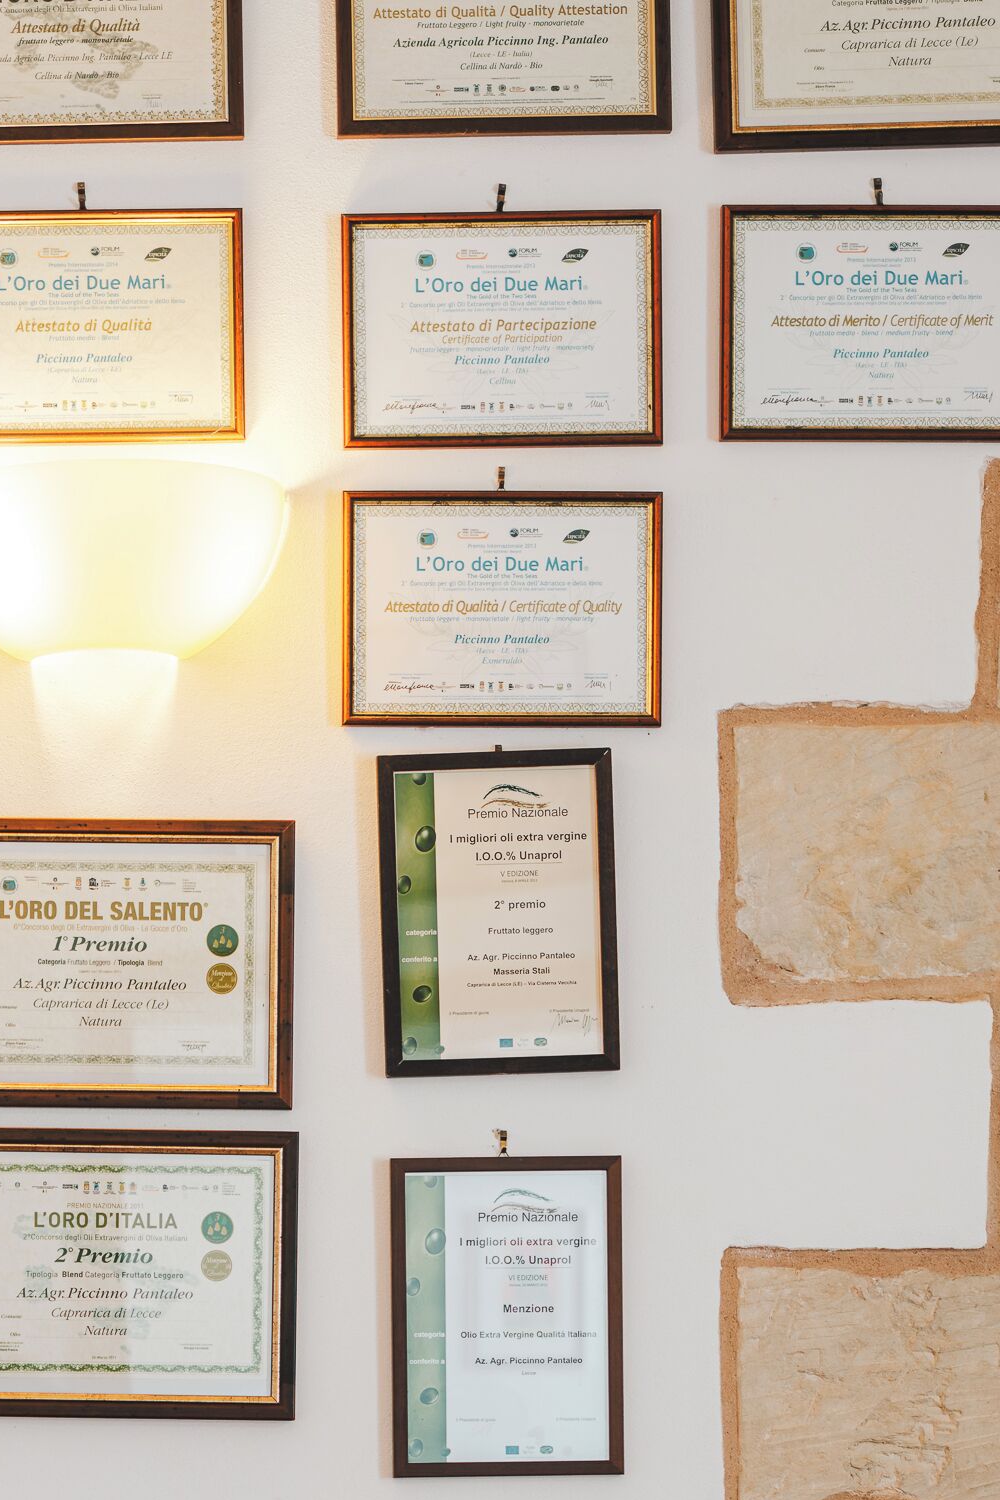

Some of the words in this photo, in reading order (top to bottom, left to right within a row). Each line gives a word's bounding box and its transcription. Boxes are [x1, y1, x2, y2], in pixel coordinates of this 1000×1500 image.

[373, 7, 432, 19] Attestato
[436, 6, 447, 18] di
[451, 5, 496, 21] Qualità
[509, 4, 555, 19] Quality
[558, 3, 628, 16] Attestation
[10, 19, 68, 34] Attestato
[73, 19, 86, 33] di
[89, 18, 140, 36] Qualità
[871, 18, 930, 30] Piccinno
[935, 16, 996, 28] Pantaleo
[393, 36, 436, 48] Azienda
[439, 36, 484, 50] Agricola
[487, 35, 534, 47] Piccinno
[537, 35, 559, 48] Ing.
[562, 34, 609, 45] Pantaleo
[841, 38, 901, 52] Caprarica
[905, 37, 917, 49] di
[921, 36, 952, 49] Lecce
[955, 36, 979, 48] (Le)
[888, 55, 932, 67] Natura
[52, 275, 80, 291] dei
[87, 275, 120, 290] Due
[127, 274, 165, 290] Mari
[415, 278, 464, 293] L'Oro
[471, 277, 498, 292] dei
[504, 276, 538, 291] Due
[545, 276, 583, 291] Mari
[795, 271, 844, 285] L'Oro
[850, 271, 878, 285] dei
[885, 271, 919, 285] Due
[924, 270, 963, 285] Mari
[15, 320, 80, 333] Attestato
[84, 318, 97, 332] di
[101, 318, 153, 334] Qualità
[410, 321, 475, 333] Attestato
[478, 320, 492, 332] di
[496, 318, 597, 334] Partecipazione
[771, 315, 826, 327] Attestato
[828, 314, 840, 326] di
[842, 314, 880, 326] Merito
[890, 313, 947, 327] Certificate
[950, 314, 961, 327] of
[963, 314, 994, 326] Merit
[442, 334, 490, 344] Certificate
[492, 334, 503, 345] of
[504, 333, 563, 345] Participation
[416, 557, 465, 572] L'Oro
[472, 557, 498, 571] dei
[505, 556, 539, 571] Due
[545, 556, 583, 571] Mari
[384, 601, 440, 614] Attestato
[442, 601, 454, 613] di
[456, 600, 498, 615] Qualità
[509, 601, 566, 614] Certificate
[569, 601, 580, 615] of
[583, 601, 622, 616] Quality
[468, 808, 508, 819] Premio
[511, 807, 568, 818] Nazionale
[450, 834, 453, 843] I
[456, 832, 497, 846] migliori
[500, 832, 513, 842] oli
[516, 832, 543, 842] extra
[547, 832, 587, 844] vergine
[476, 851, 516, 861] I.O.O.%
[519, 850, 562, 863] Unaprol
[0, 900, 57, 919] L'ORO
[65, 901, 104, 920] DEL
[110, 901, 203, 921] SALENTO
[494, 899, 505, 910] 2°
[508, 899, 546, 912] premio
[34, 1212, 89, 1229] L'ORO
[95, 1212, 178, 1230] D'ITALIA
[478, 1212, 518, 1222] Premio
[522, 1212, 578, 1222] Nazionale
[503, 1304, 555, 1313] Menzione
